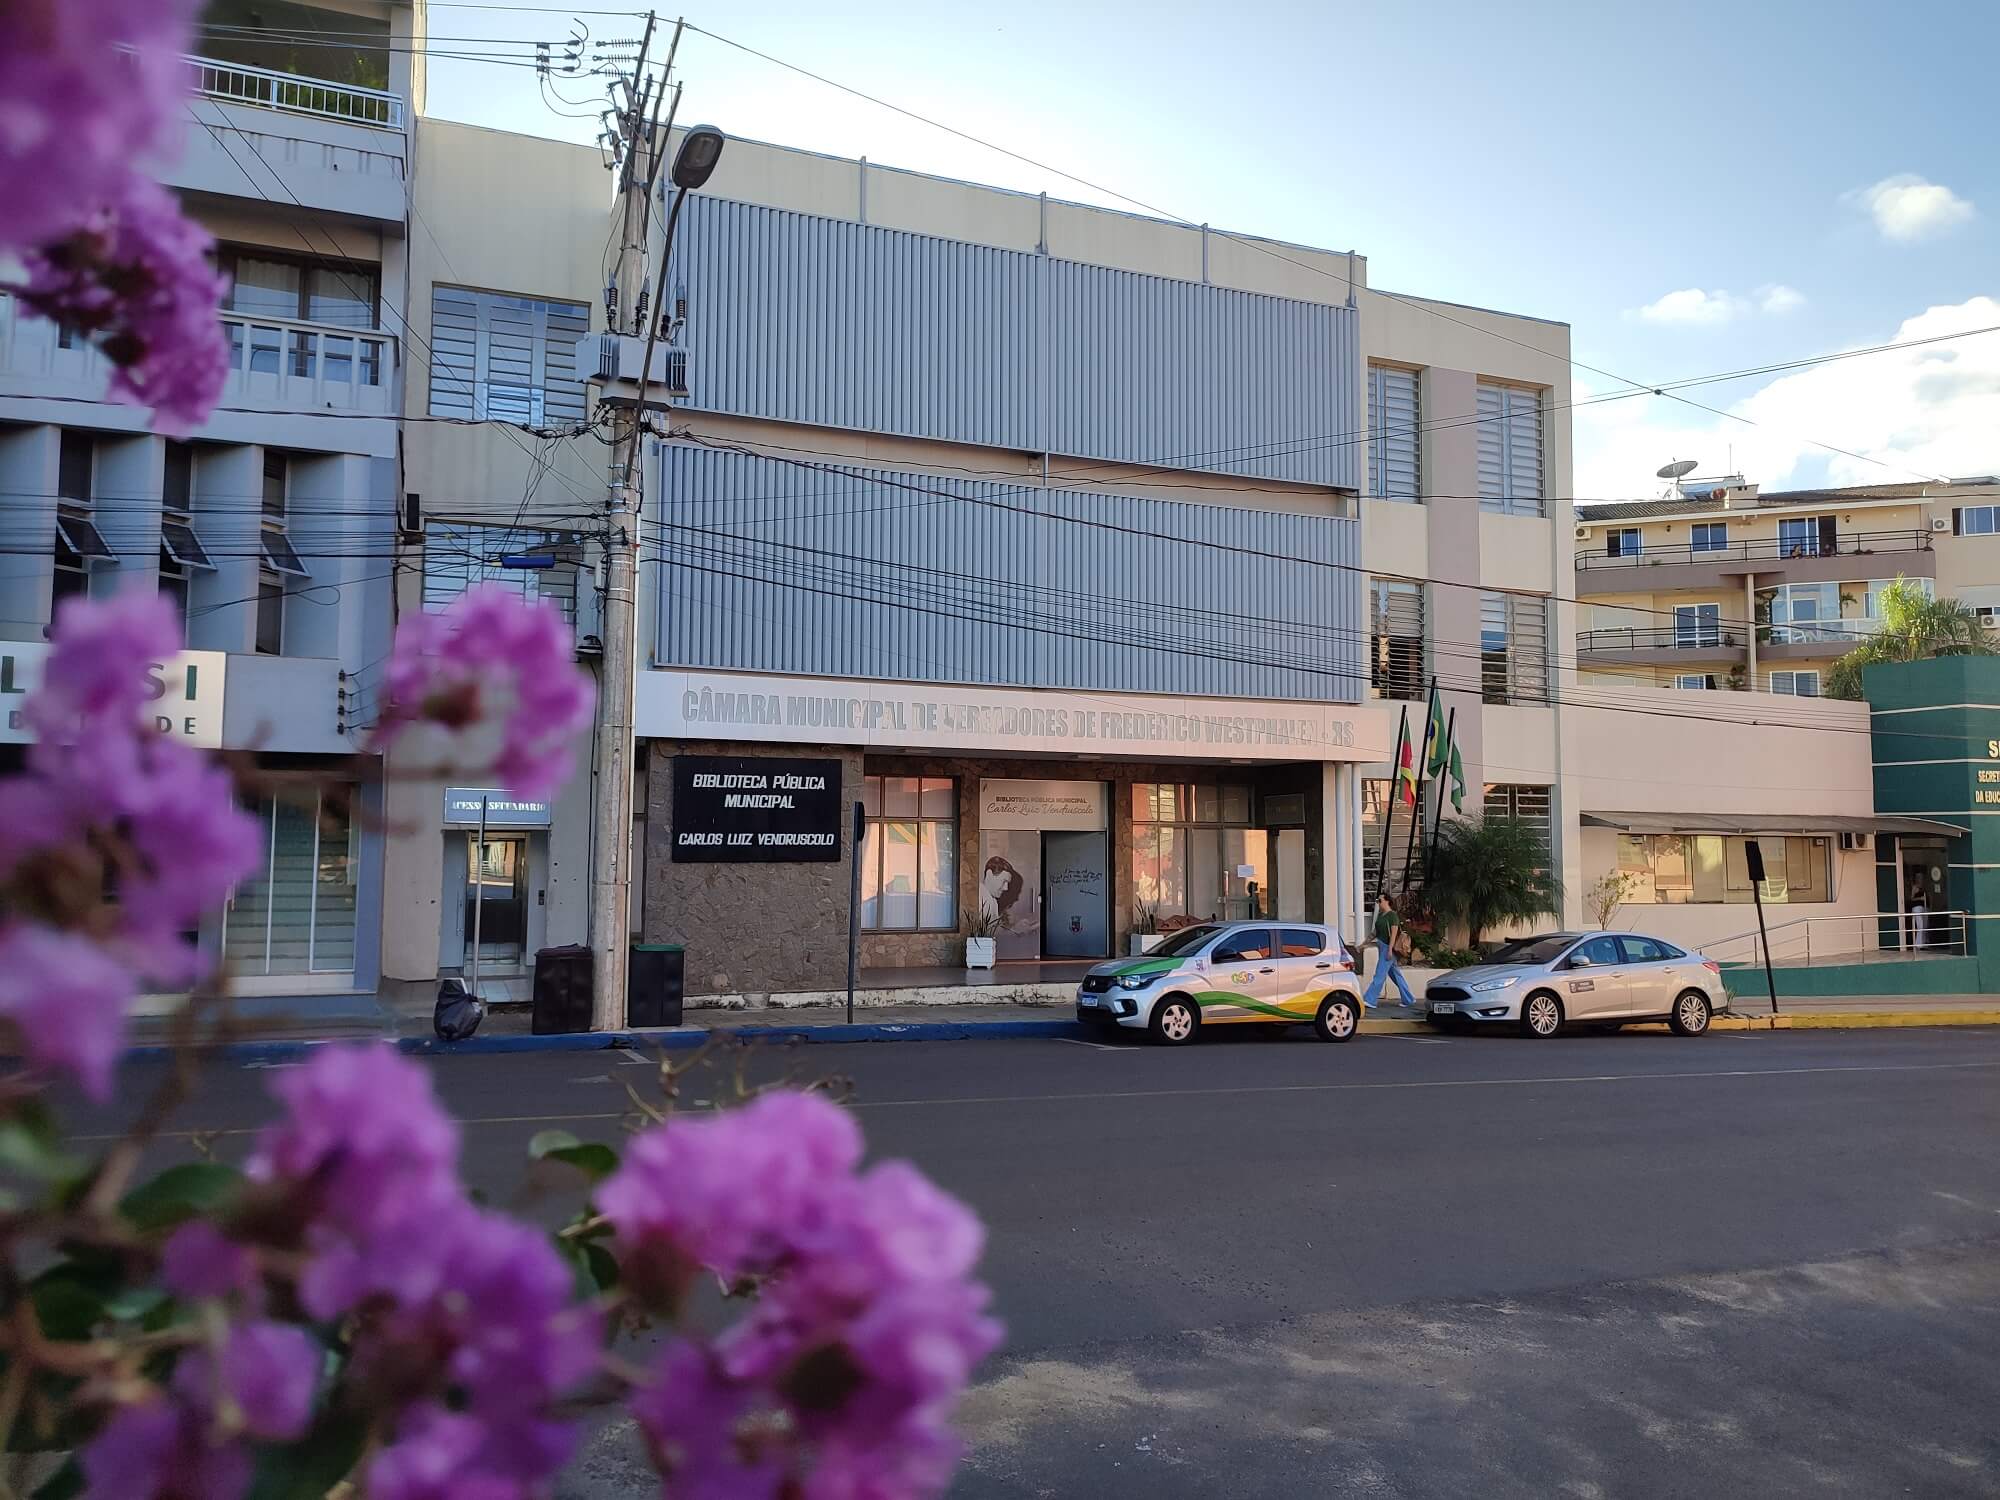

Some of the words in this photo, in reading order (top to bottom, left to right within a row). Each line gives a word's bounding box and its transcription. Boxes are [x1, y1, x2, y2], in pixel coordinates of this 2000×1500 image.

[682, 686, 783, 726] CÂMARA
[786, 695, 907, 730] MUNICIPAL
[911, 702, 938, 731] DE
[941, 703, 1069, 738] VEREADORES
[1072, 710, 1097, 739] DE
[1100, 711, 1200, 743] FREDERICO
[1204, 715, 1319, 747] WESTPHALEN
[692, 773, 768, 789] BIBLIOTECA
[772, 772, 826, 790] PÚBLICA
[724, 794, 796, 809] MUNICIPAL
[986, 802, 1017, 814] Carlos
[678, 832, 724, 846] CARLOS
[726, 833, 754, 846] LUIZ
[757, 833, 835, 846] VENDRUSCOLO
